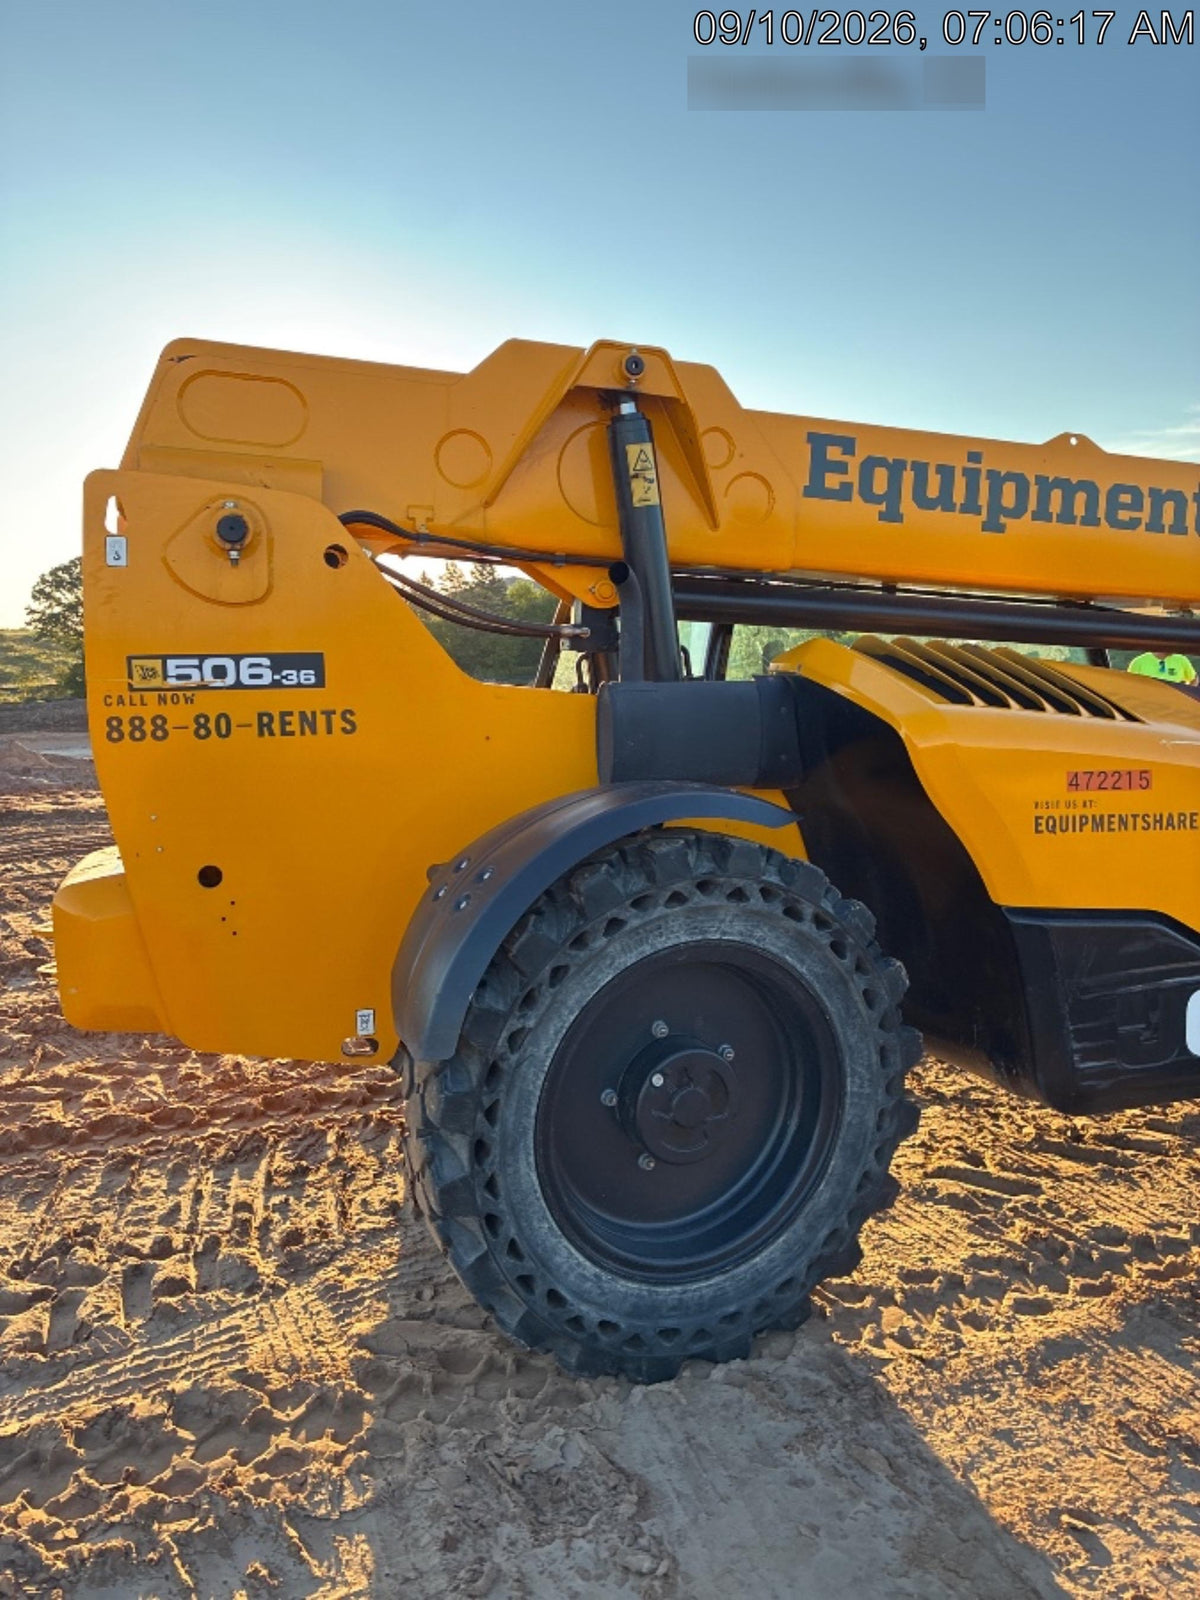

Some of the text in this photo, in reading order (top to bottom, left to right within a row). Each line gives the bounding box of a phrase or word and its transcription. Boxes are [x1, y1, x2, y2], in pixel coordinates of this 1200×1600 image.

[166, 657, 316, 688] 506-36
[104, 692, 196, 707] CALL NOW
[106, 709, 357, 743] 888-80-RENTS
[1068, 770, 1150, 791] 472215
[1034, 812, 1199, 835] EQUIPMENTSHARE
